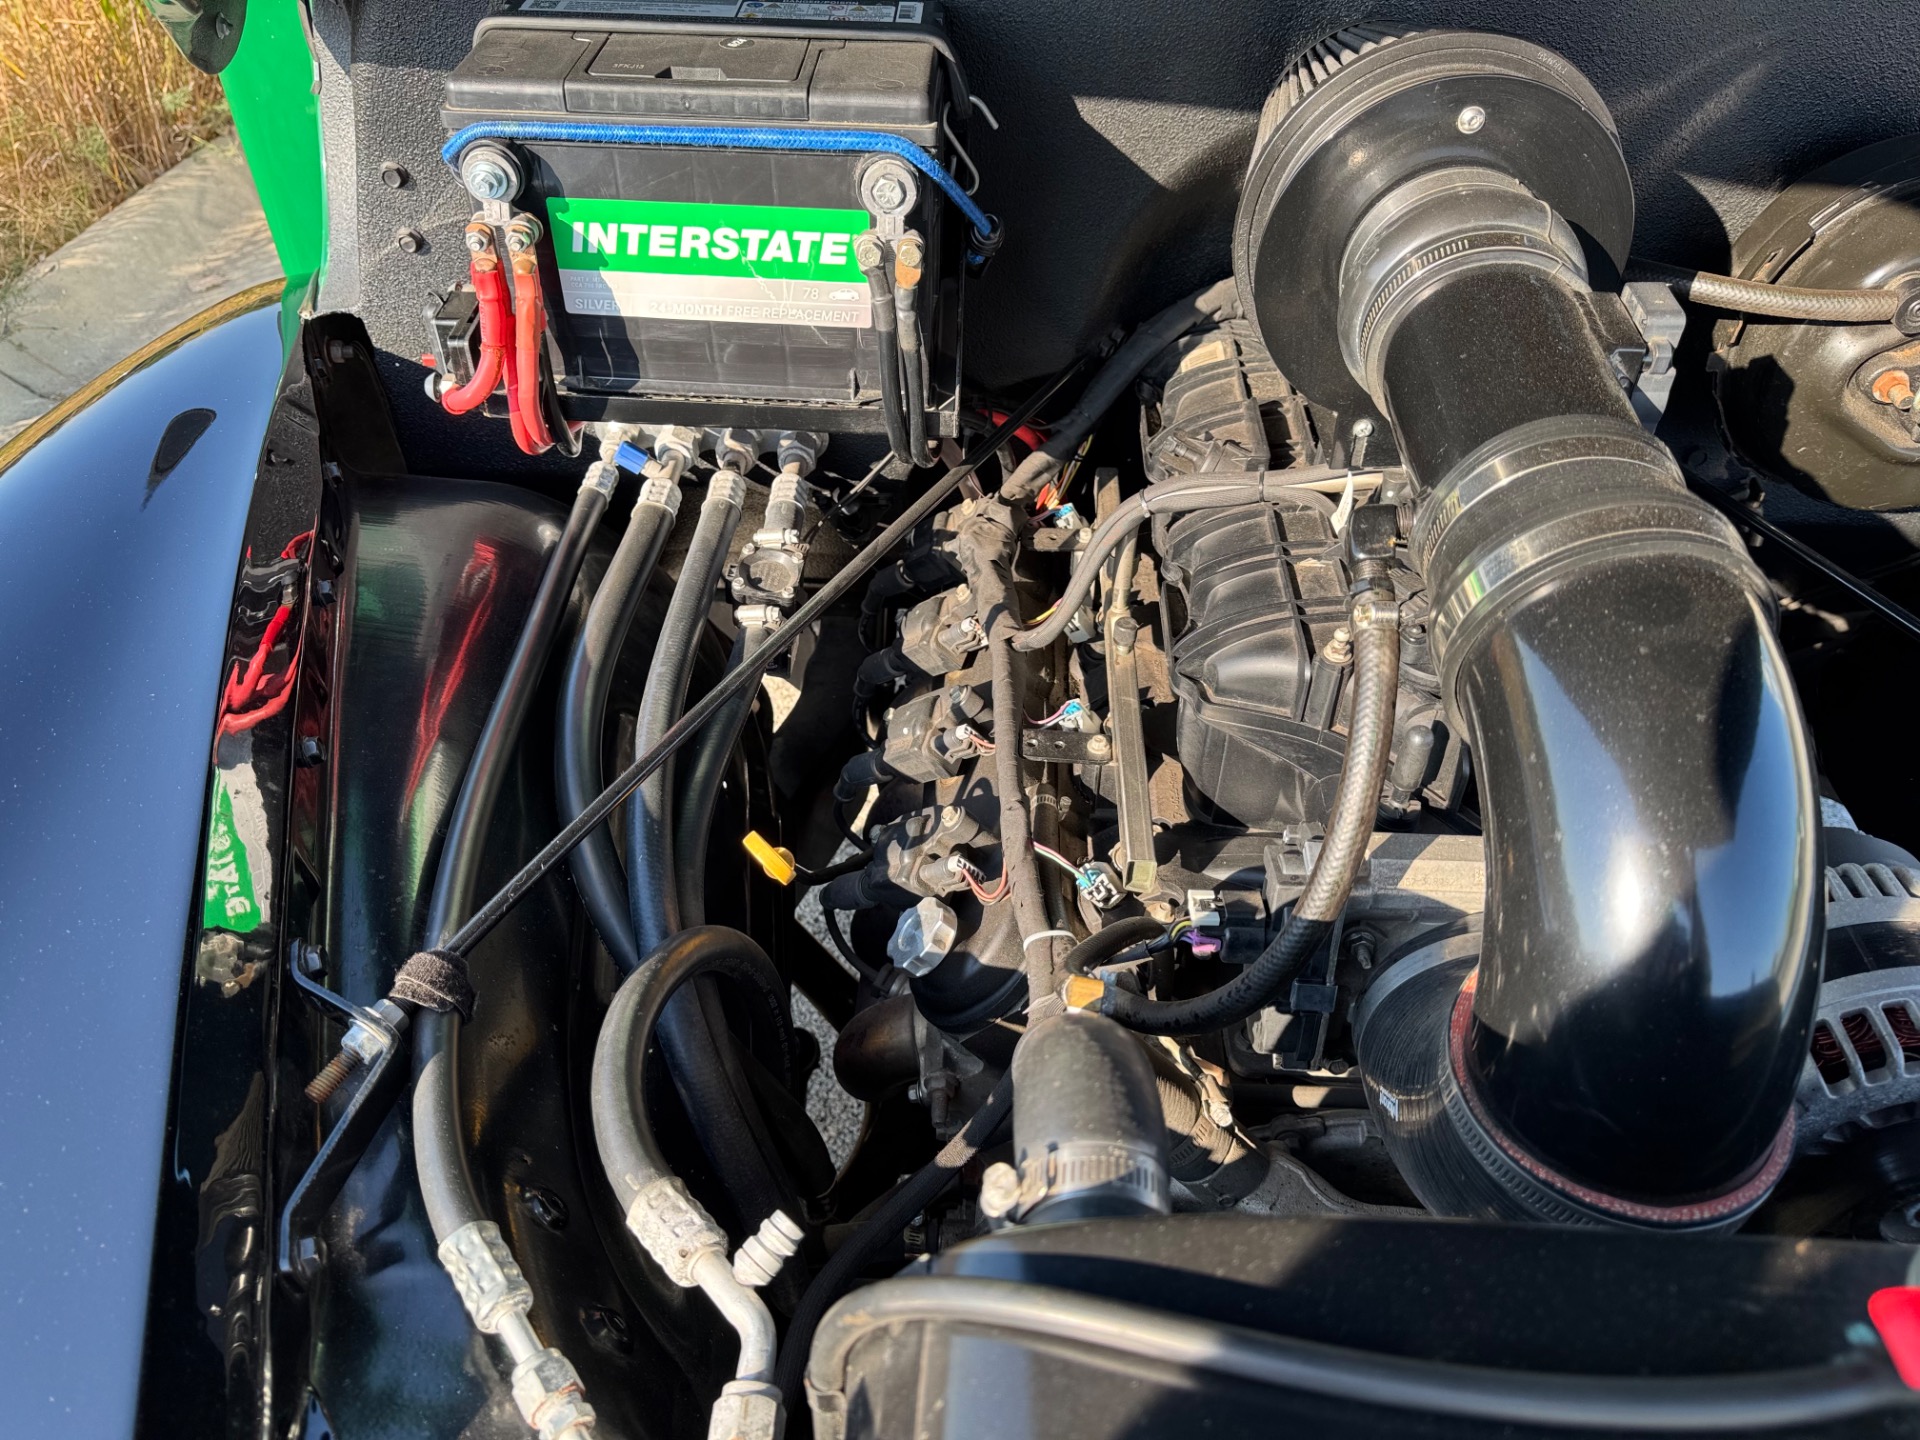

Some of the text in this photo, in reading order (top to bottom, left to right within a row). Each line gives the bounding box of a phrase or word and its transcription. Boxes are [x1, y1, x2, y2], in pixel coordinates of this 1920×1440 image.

[571, 221, 851, 265] INTERSTATE
[802, 287, 819, 299] 78
[575, 298, 620, 311] SILVER
[650, 301, 860, 323] 24-MONTH FREE REPLACEMENT
